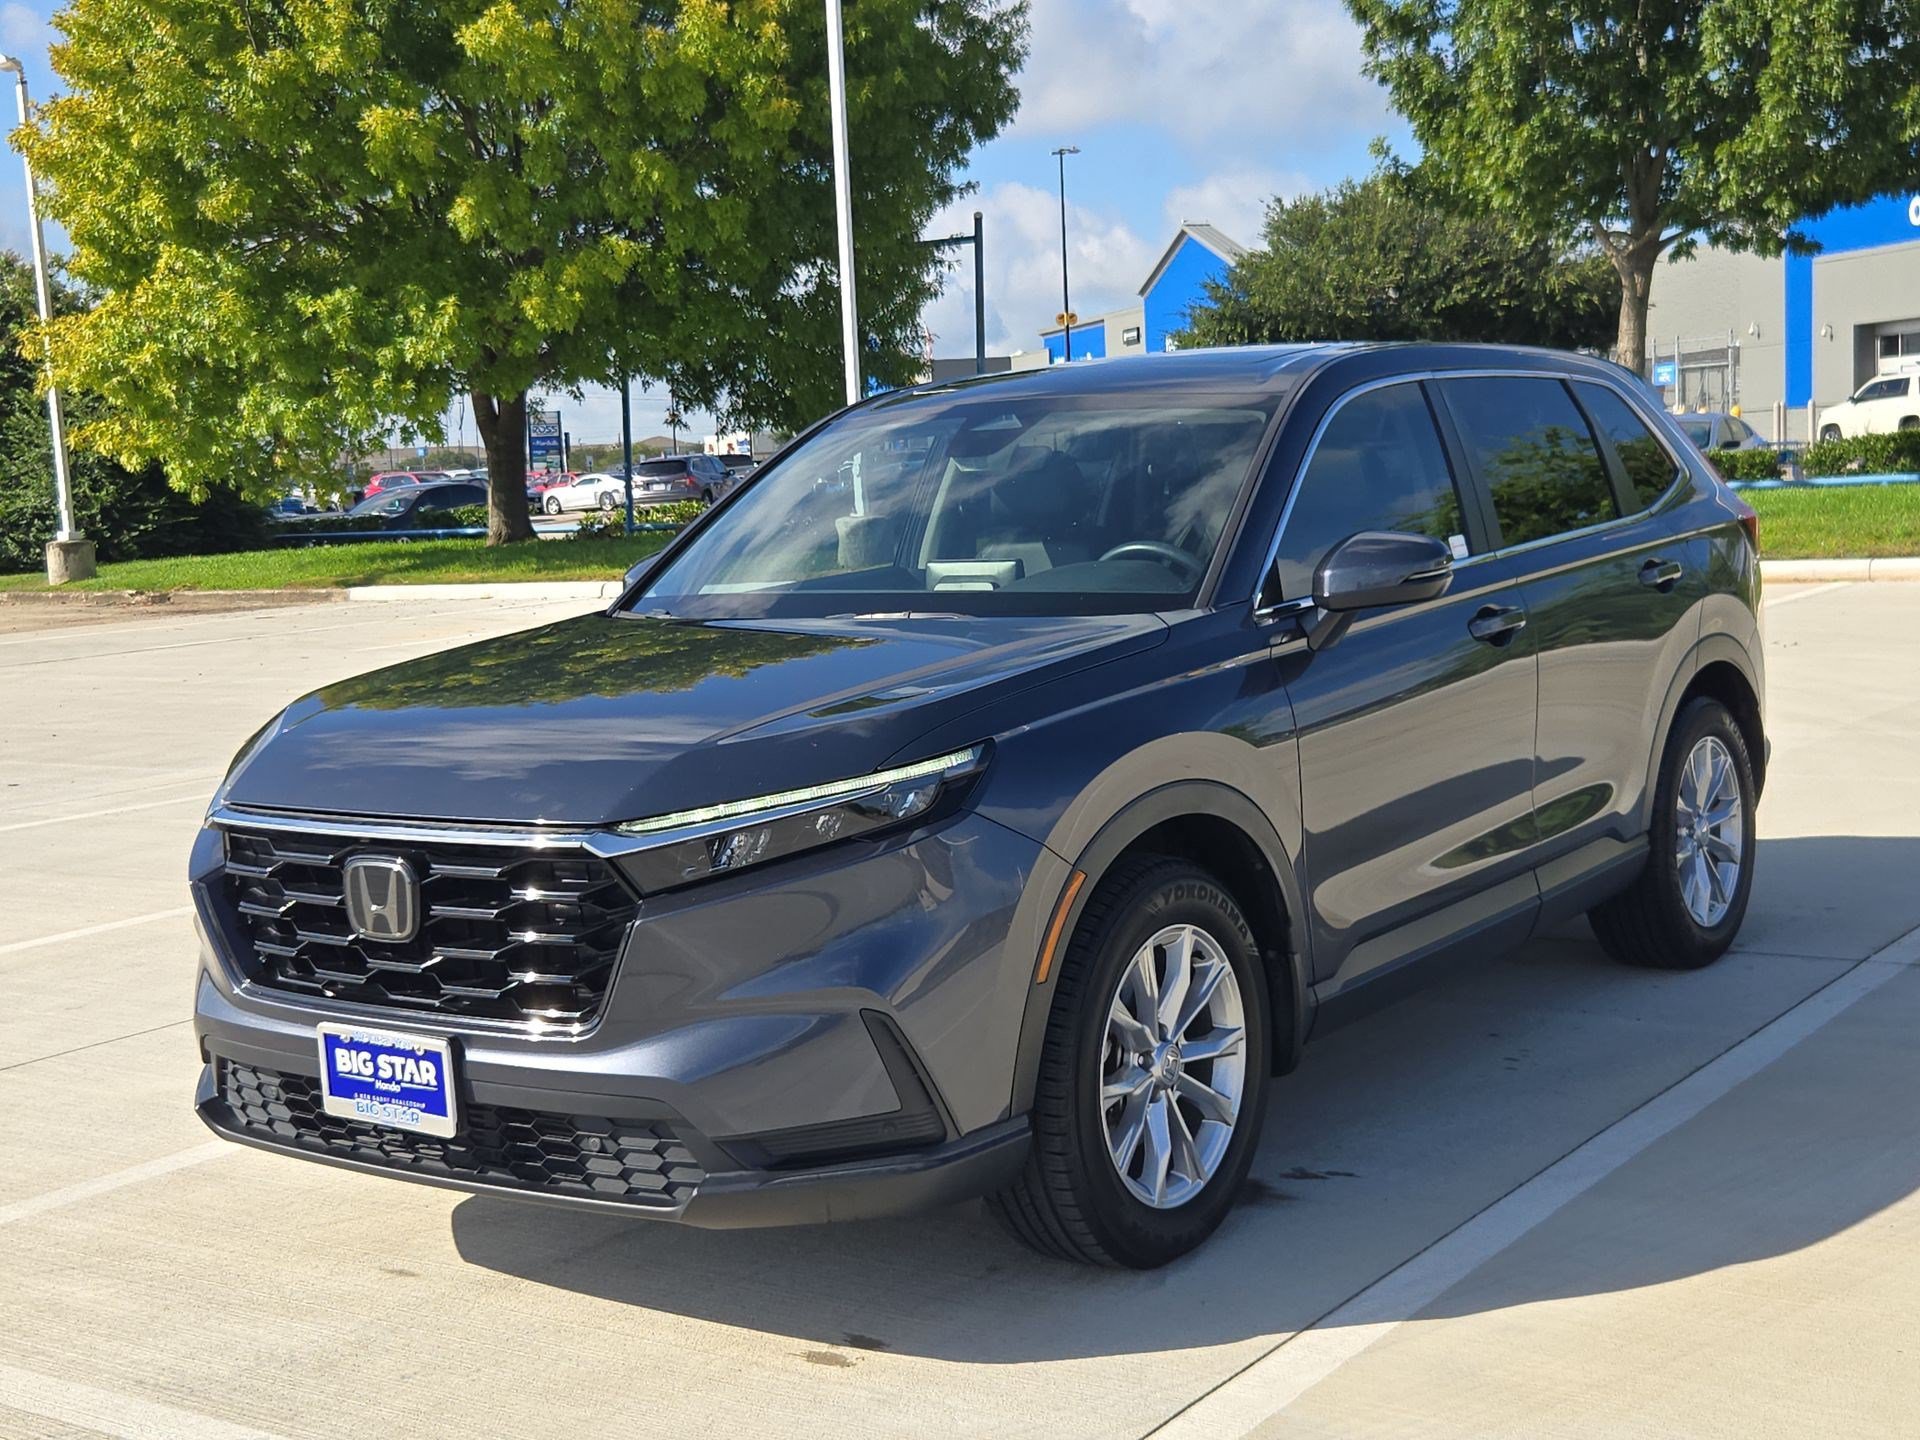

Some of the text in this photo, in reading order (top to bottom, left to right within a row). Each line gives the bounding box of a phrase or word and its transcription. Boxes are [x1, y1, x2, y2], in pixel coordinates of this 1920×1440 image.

[533, 425, 558, 434] ROSS
[1161, 883, 1249, 940] YOKOHAMA
[335, 1047, 438, 1086] BIG STAR
[375, 1079, 401, 1092] Honda
[356, 1101, 379, 1116] BIG
